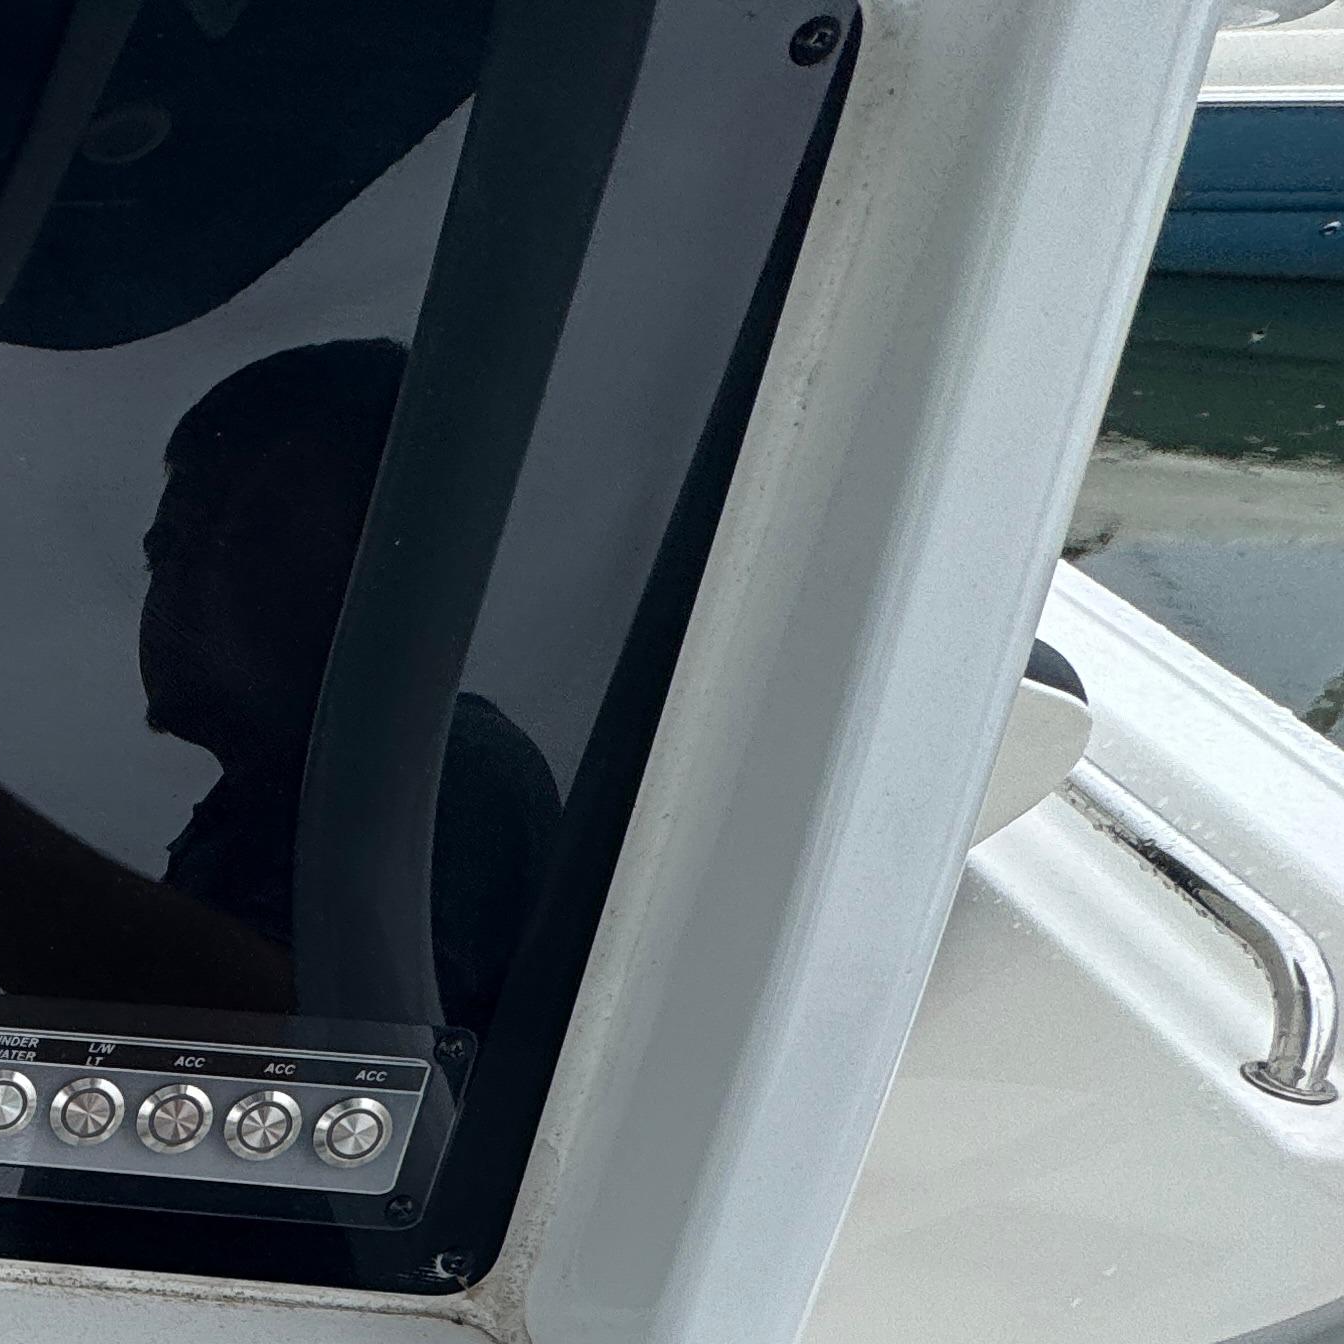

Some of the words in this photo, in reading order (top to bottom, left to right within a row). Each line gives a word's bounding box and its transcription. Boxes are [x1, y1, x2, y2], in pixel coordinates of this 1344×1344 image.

[88, 1042, 116, 1055] L/W
[85, 1055, 103, 1067] LT
[173, 1056, 207, 1069] ACC
[263, 1063, 297, 1076] ACC
[355, 1070, 389, 1083] ACC
